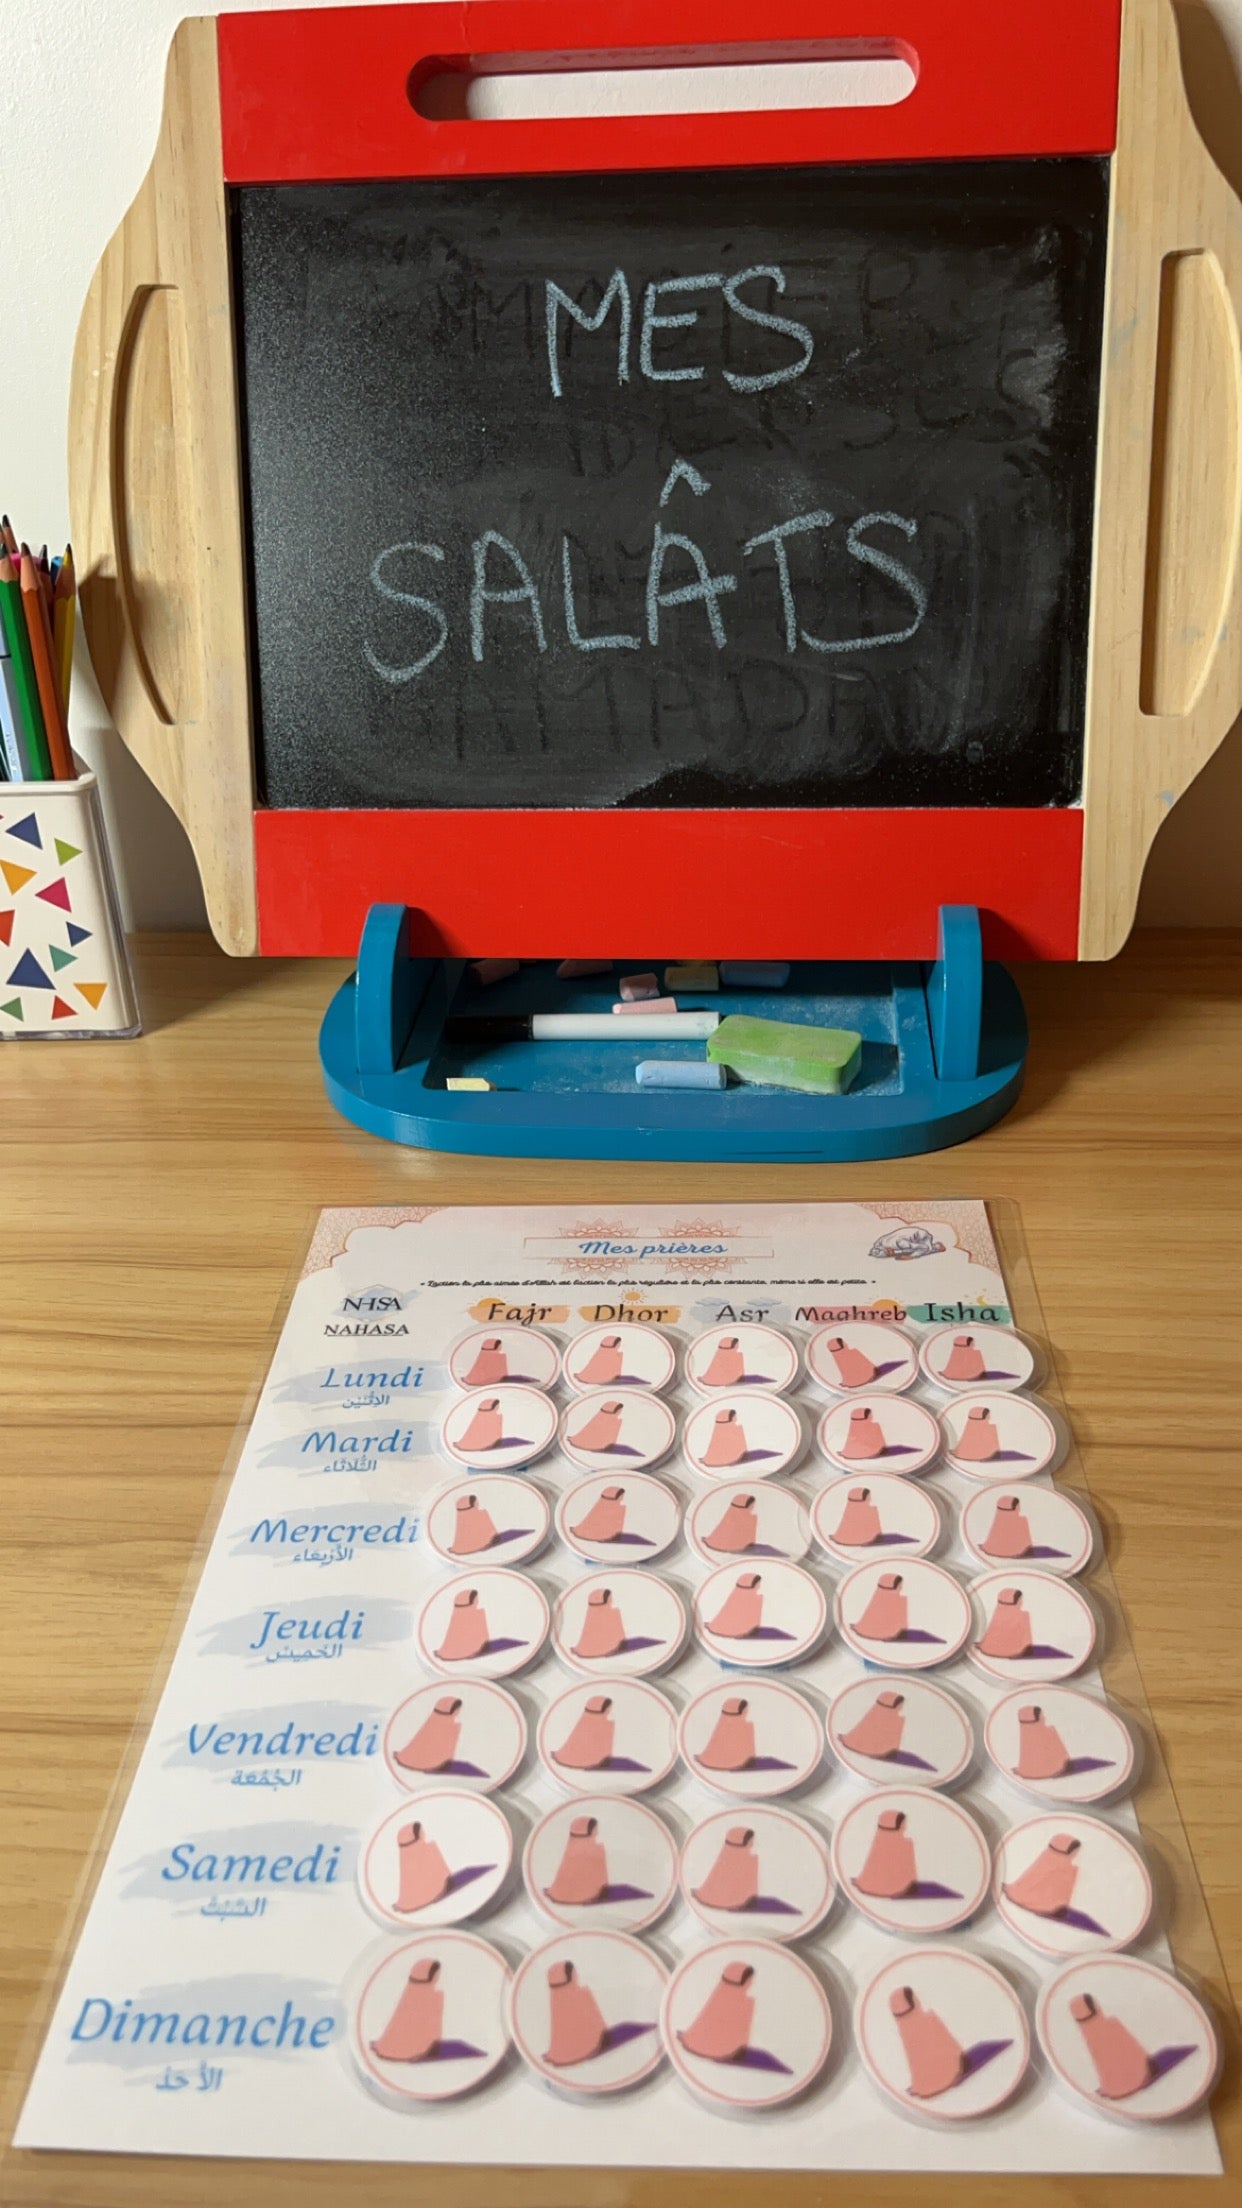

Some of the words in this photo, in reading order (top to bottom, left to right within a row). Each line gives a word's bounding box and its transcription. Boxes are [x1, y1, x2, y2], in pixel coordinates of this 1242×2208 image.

[544, 265, 814, 397] MES
[364, 459, 927, 683] SALÂTS
[579, 1240, 637, 1255] Mes
[639, 1242, 728, 1259] prières
[487, 1302, 553, 1326] Fajr
[594, 1303, 669, 1323] Dhor
[715, 1304, 769, 1322] Asr
[924, 1301, 1000, 1322] Isha
[323, 1323, 410, 1336] NAHASA
[320, 1366, 424, 1388] Lundi
[301, 1429, 414, 1453] Mardi
[250, 1517, 421, 1544] Mercredi
[250, 1610, 365, 1649] Jeudi
[188, 1722, 379, 1757] Vendredi
[161, 1843, 341, 1883] Samedi
[70, 1998, 336, 2049] Dimanche
